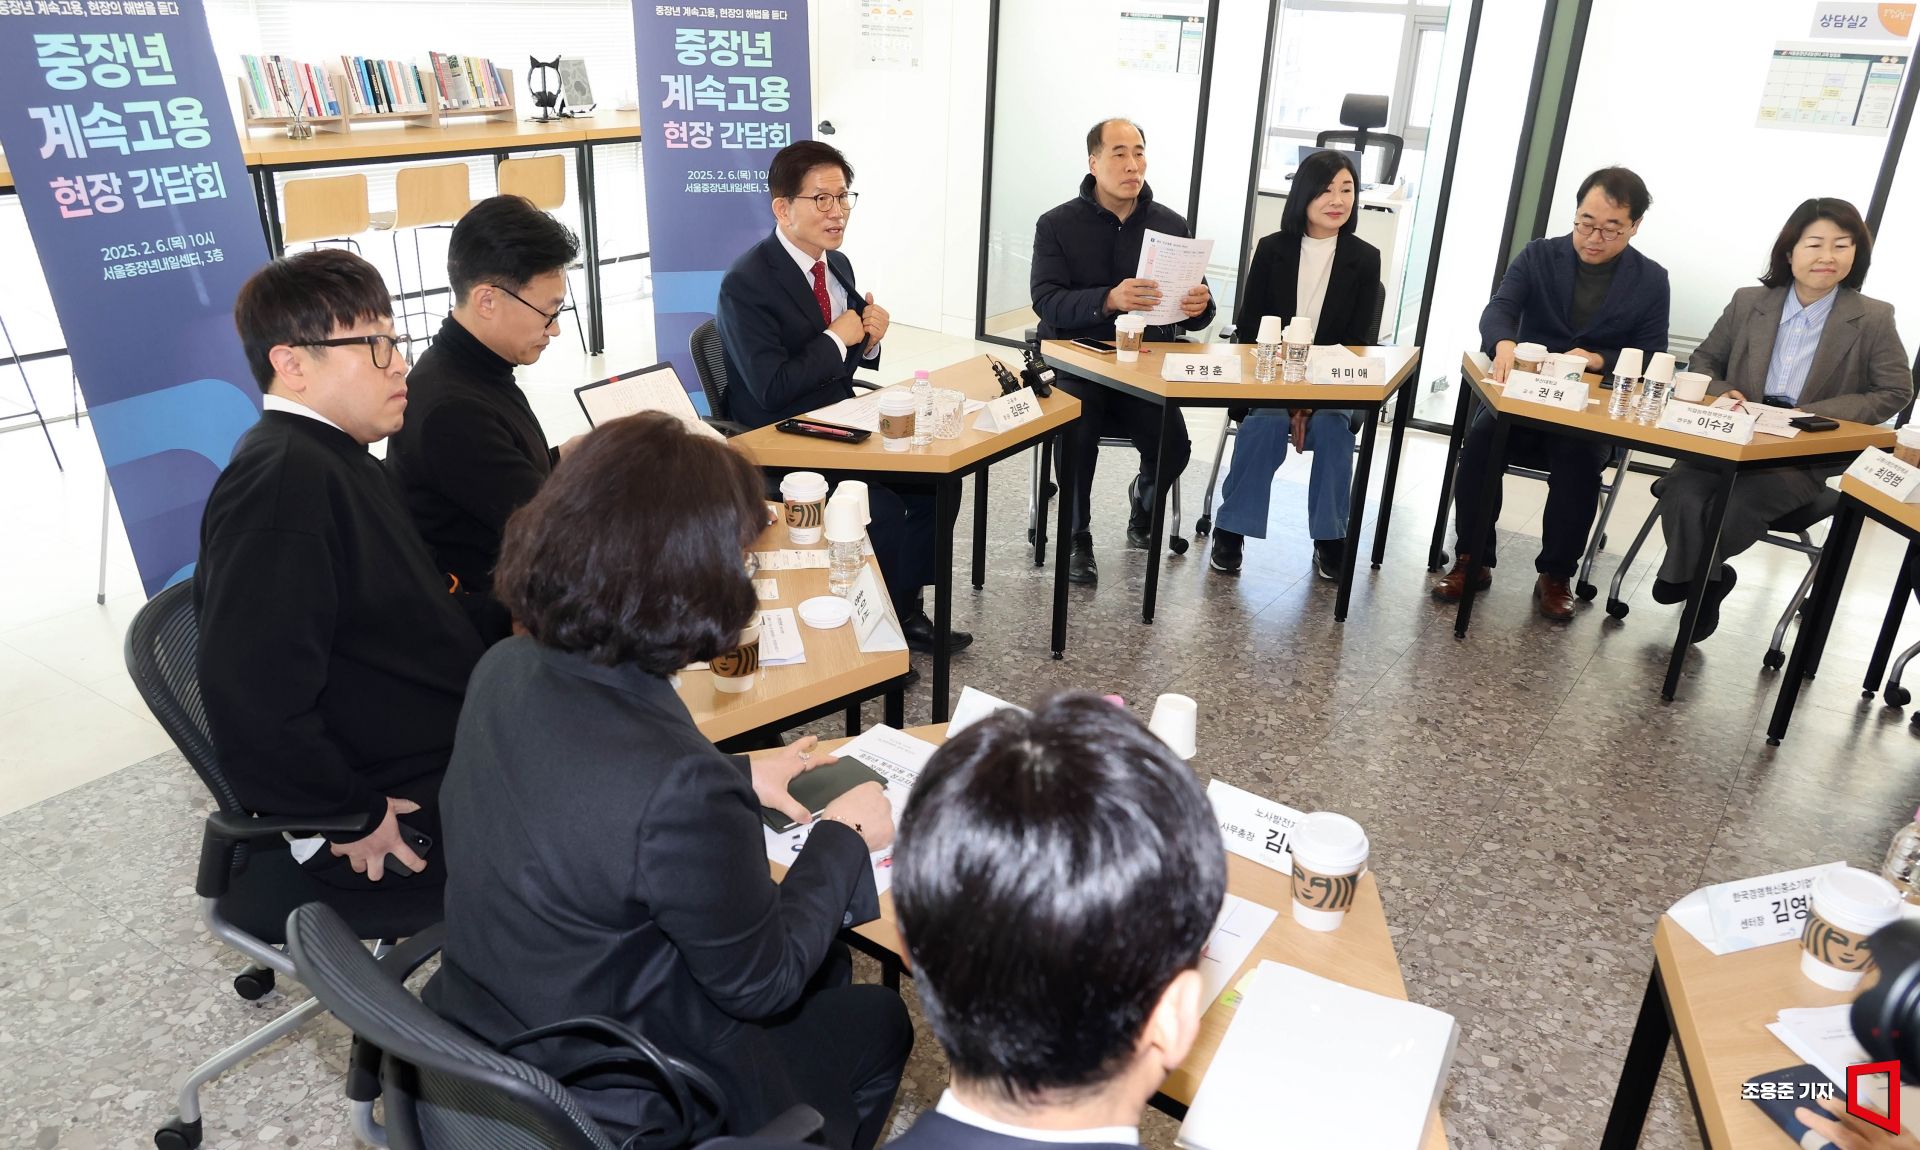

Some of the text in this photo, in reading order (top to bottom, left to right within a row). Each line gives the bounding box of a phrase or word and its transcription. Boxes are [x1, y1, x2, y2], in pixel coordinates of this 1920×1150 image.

[38, 2, 88, 17] 계속고용,
[89, 2, 123, 15] 현장의
[125, 2, 156, 15] 해법을
[158, 2, 179, 15] 듣다
[655, 5, 788, 20] 중장년 계속고용, 현장의 해법을 듣다
[1820, 14, 1868, 29] 상담실2
[33, 33, 177, 90] 중장년
[674, 28, 773, 68] 중장년
[660, 74, 791, 113] 계속고용
[28, 97, 211, 159] 계속고용
[663, 121, 791, 149] 현장 간담회
[685, 183, 762, 195] 서울중장년내일센터,
[687, 170, 716, 180] 2025.
[49, 162, 227, 218] 현장 간담회
[101, 244, 141, 261] 2025.
[188, 231, 215, 248] 10시
[103, 248, 224, 281] 서울중장년내일센터, 3층
[1009, 401, 1030, 417] 김문수
[1697, 416, 1734, 434] 이수경
[1874, 467, 1905, 488] 최영범
[1220, 821, 1293, 854] 사무총장 김
[1732, 876, 1817, 903] 한국경영혁신중소기업
[1741, 893, 1813, 930] 센터장 김영
